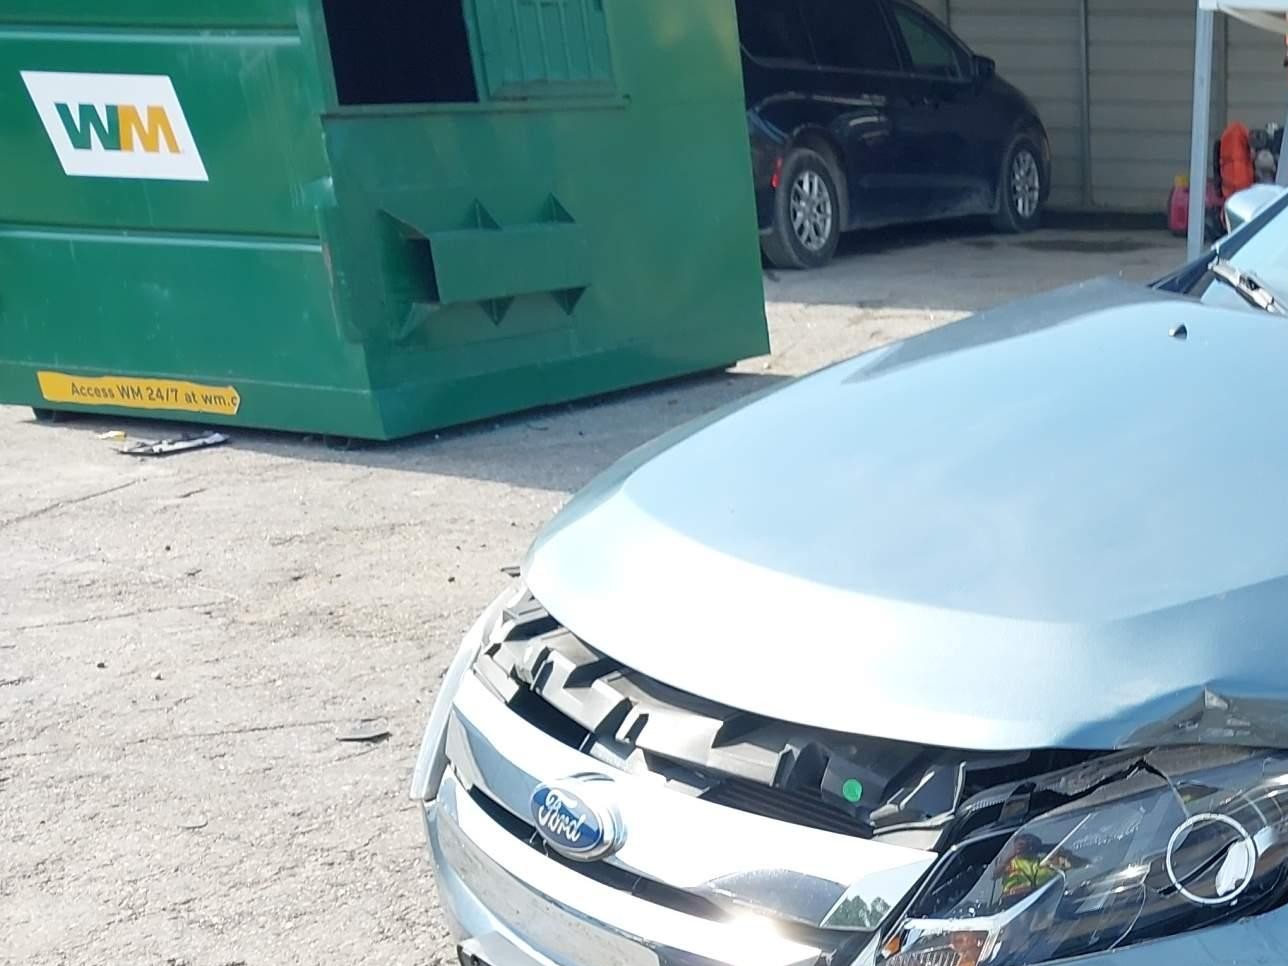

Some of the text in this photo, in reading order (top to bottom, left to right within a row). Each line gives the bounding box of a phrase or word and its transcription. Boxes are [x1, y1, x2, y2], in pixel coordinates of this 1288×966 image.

[54, 102, 182, 154] WM
[71, 382, 115, 399] Access
[118, 384, 143, 401] WM
[146, 387, 179, 403] 24/7
[184, 391, 198, 404] at
[538, 788, 586, 842] Ford
